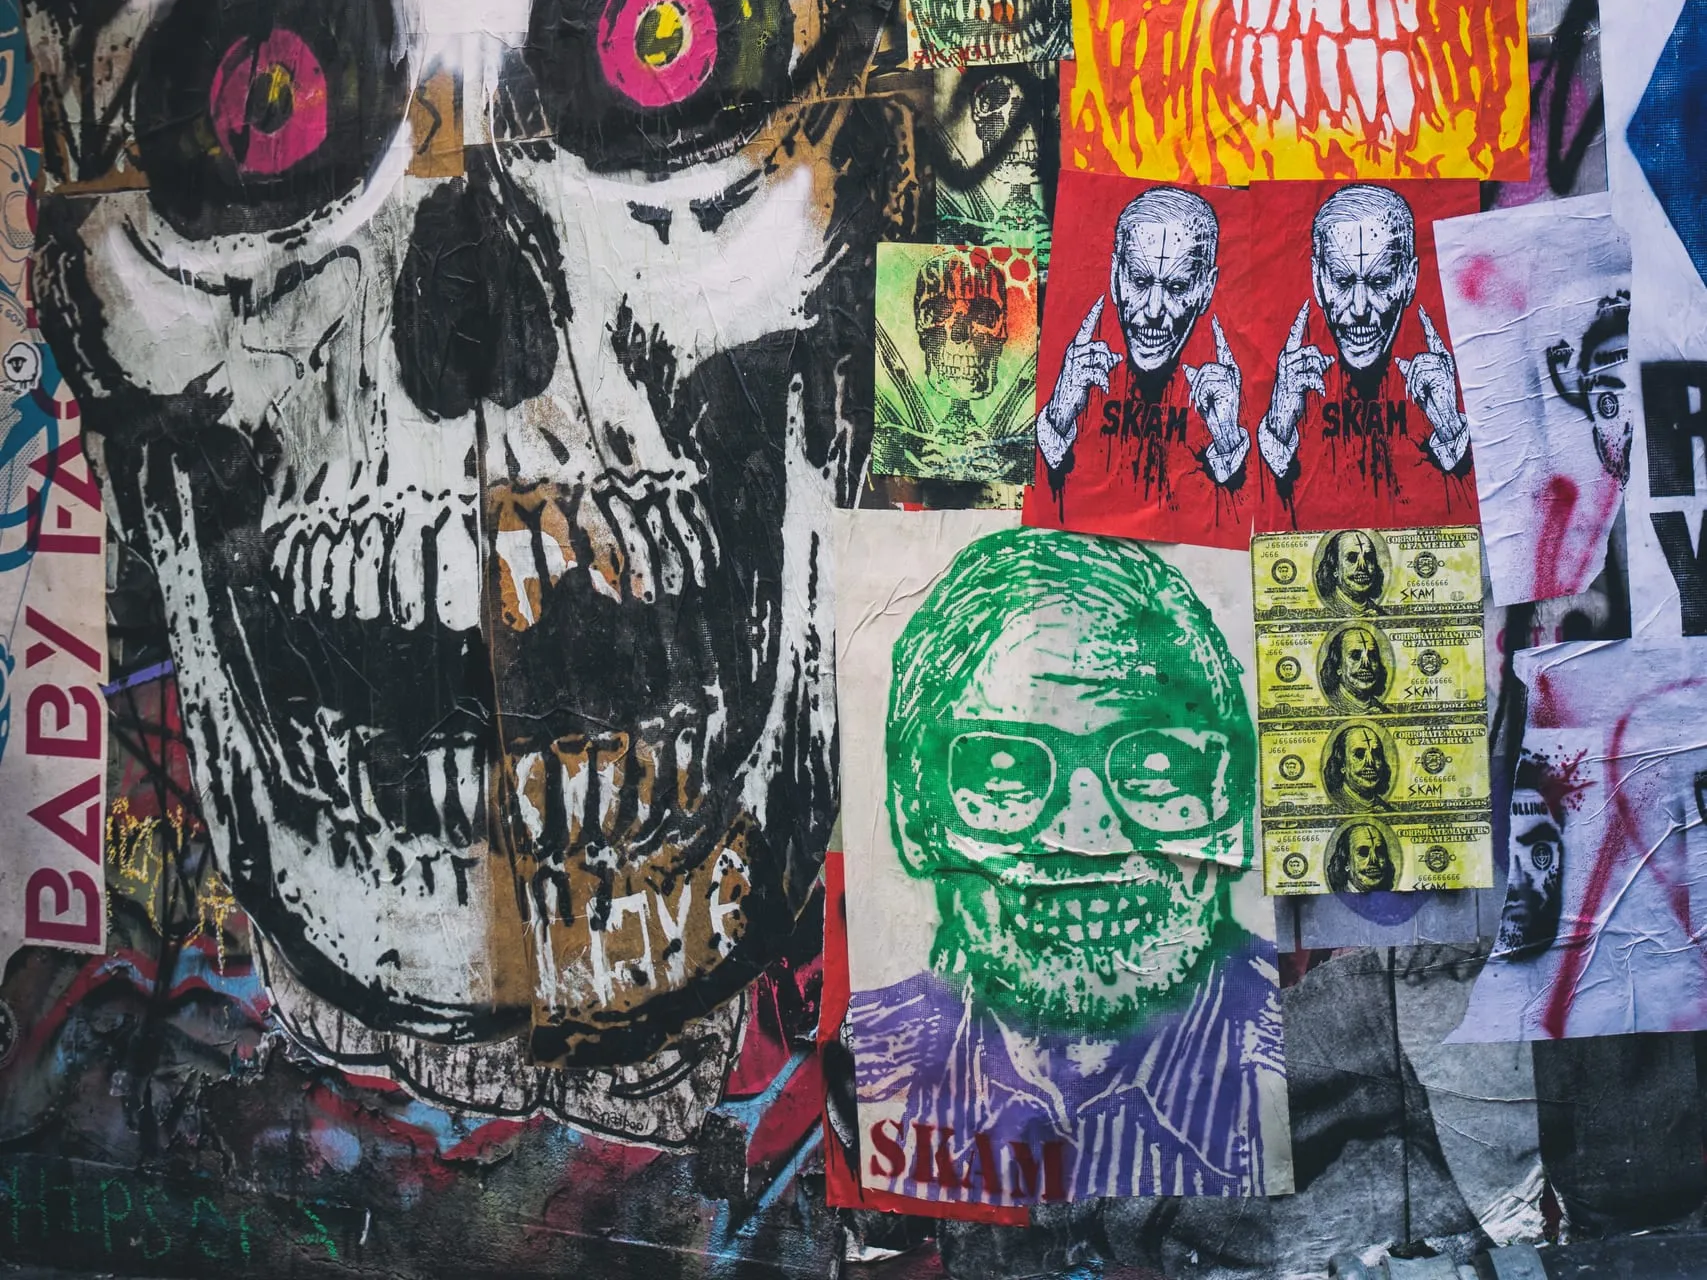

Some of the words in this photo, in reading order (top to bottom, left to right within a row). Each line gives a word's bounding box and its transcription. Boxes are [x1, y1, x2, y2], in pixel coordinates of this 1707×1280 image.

[1101, 399, 1188, 442] SKAM
[1322, 399, 1407, 438] SKAM
[1415, 540, 1466, 549] AMERICA
[1400, 588, 1435, 602] SKAM
[1418, 638, 1470, 647] AMERICA
[1404, 686, 1438, 699] SKAM
[1422, 736, 1474, 745] AMERICA
[25, 605, 101, 946] BABY
[1408, 784, 1442, 798] SKAM
[1510, 802, 1549, 817] OLLING
[1426, 834, 1477, 843] AMERICA
[523, 848, 751, 1015] LOVE
[870, 1118, 1067, 1202] SKAM
